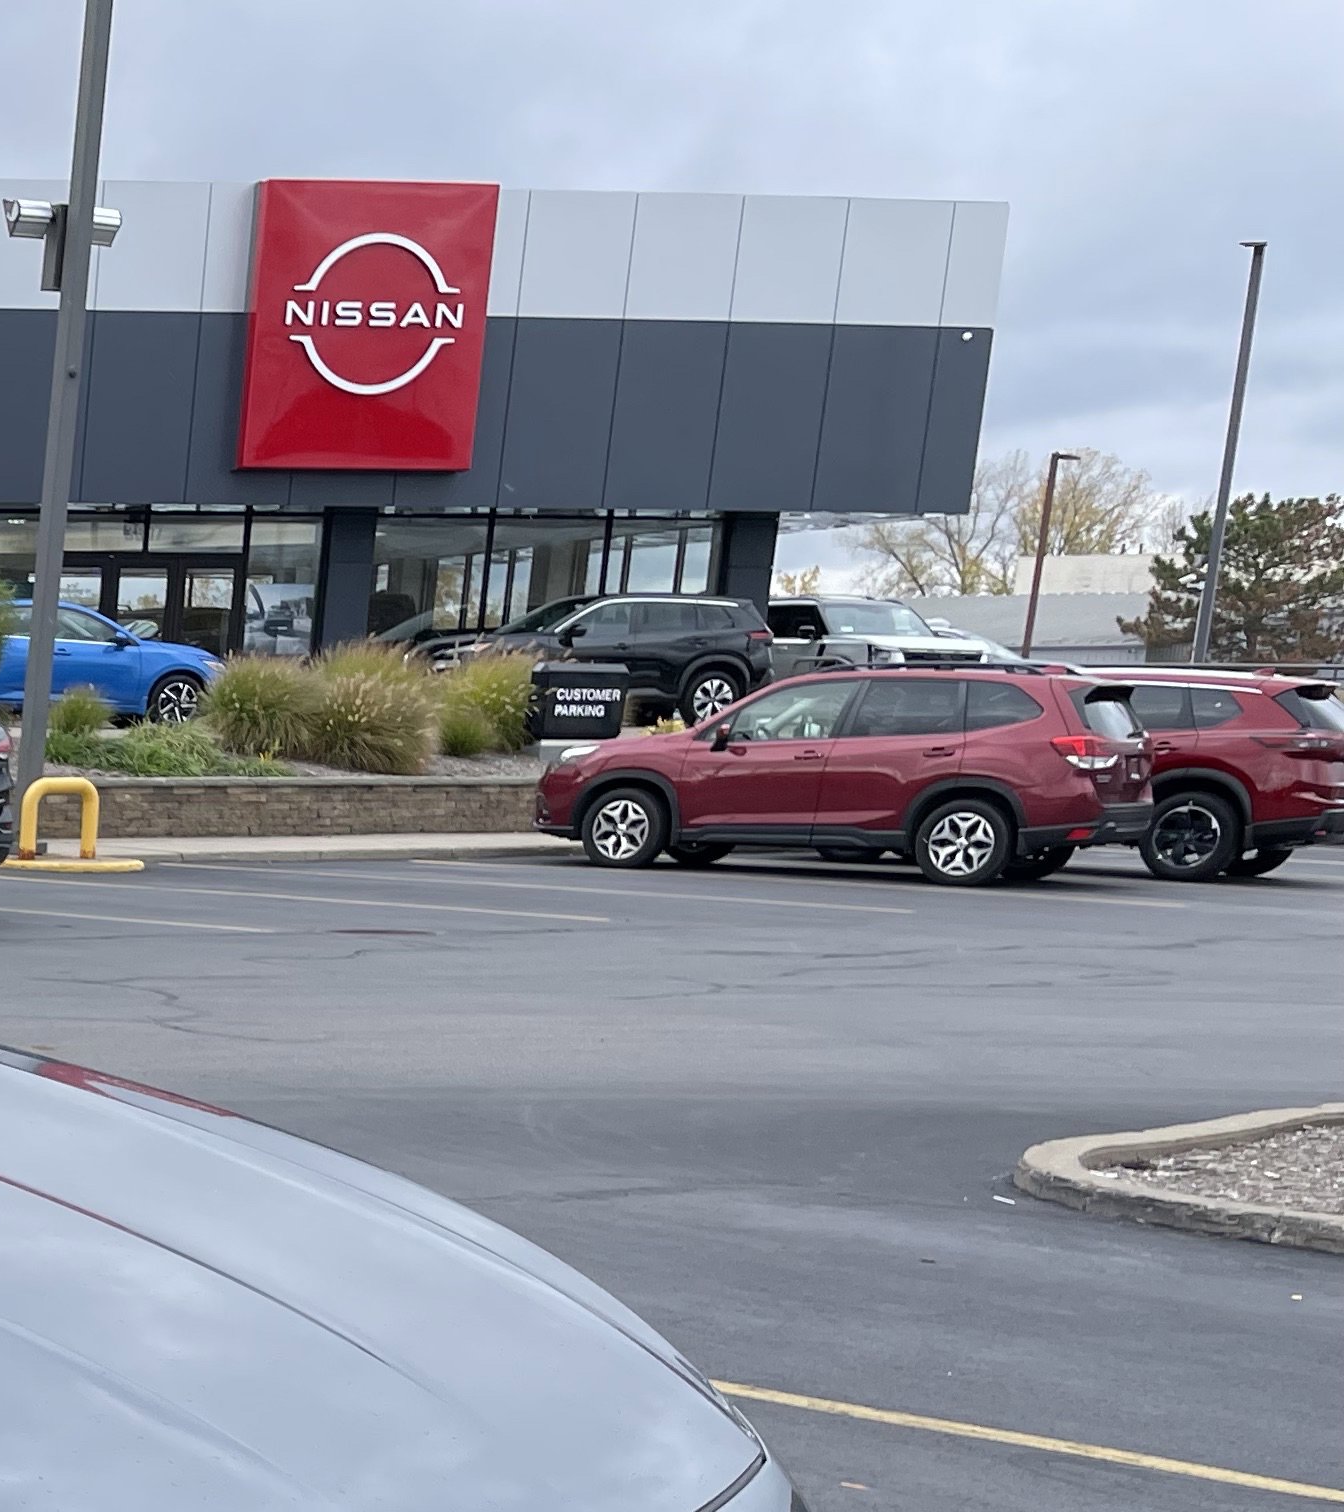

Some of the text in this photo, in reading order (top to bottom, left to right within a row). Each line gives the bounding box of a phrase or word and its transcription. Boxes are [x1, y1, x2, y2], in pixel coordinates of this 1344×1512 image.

[284, 300, 465, 329] NISSAN
[556, 688, 621, 702] CUSTOMER
[554, 704, 605, 718] PARKING
